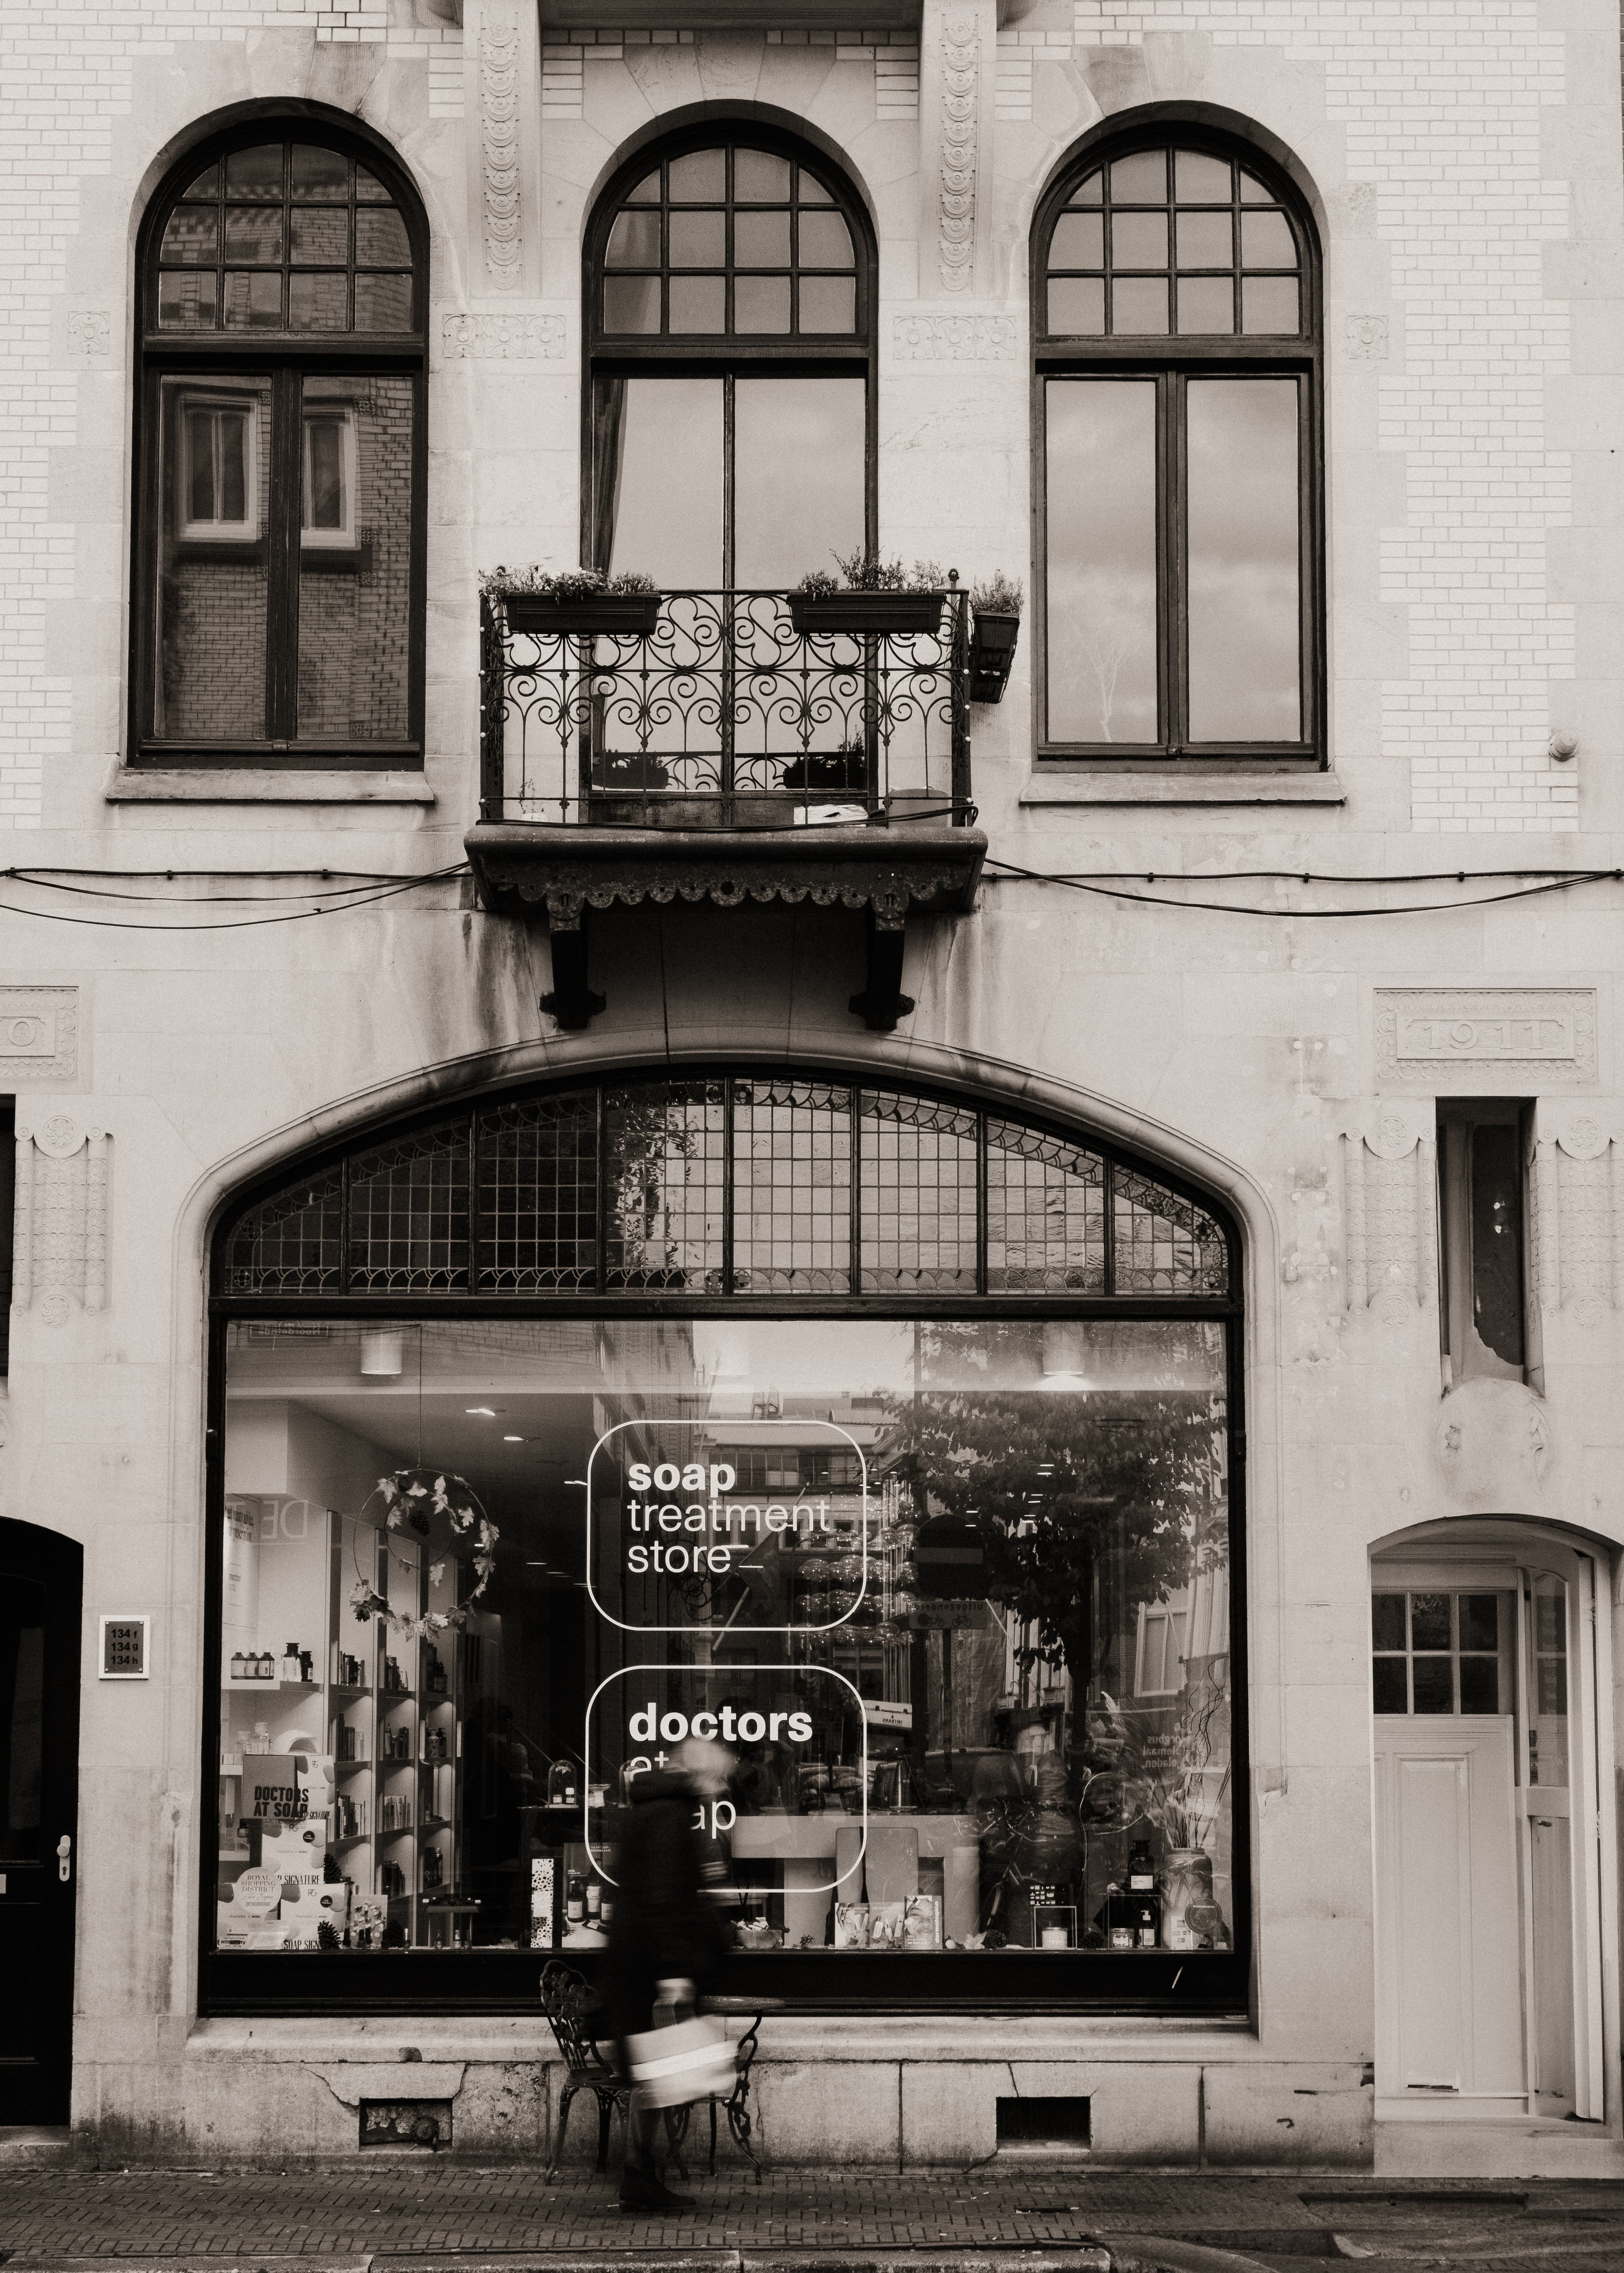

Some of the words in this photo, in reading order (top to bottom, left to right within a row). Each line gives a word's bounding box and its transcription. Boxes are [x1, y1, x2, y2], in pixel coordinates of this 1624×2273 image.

[1423, 1020, 1543, 1050] 1911
[628, 1462, 736, 1497] soap
[627, 1500, 830, 1532] treatment
[628, 1541, 732, 1573] store
[111, 1629, 130, 1638] 134
[133, 1630, 138, 1638] f
[111, 1642, 130, 1651] 134
[111, 1655, 130, 1665] 134
[629, 1703, 813, 1742] doctors
[254, 1786, 309, 1802] DOCTORS
[253, 1801, 270, 1817] AT
[274, 1802, 308, 1818] SOAP
[691, 1799, 737, 1839] ap
[284, 1875, 320, 1885] SIGNATURE
[284, 1939, 302, 1950] SOAP
[304, 1940, 320, 1950] SIGN
